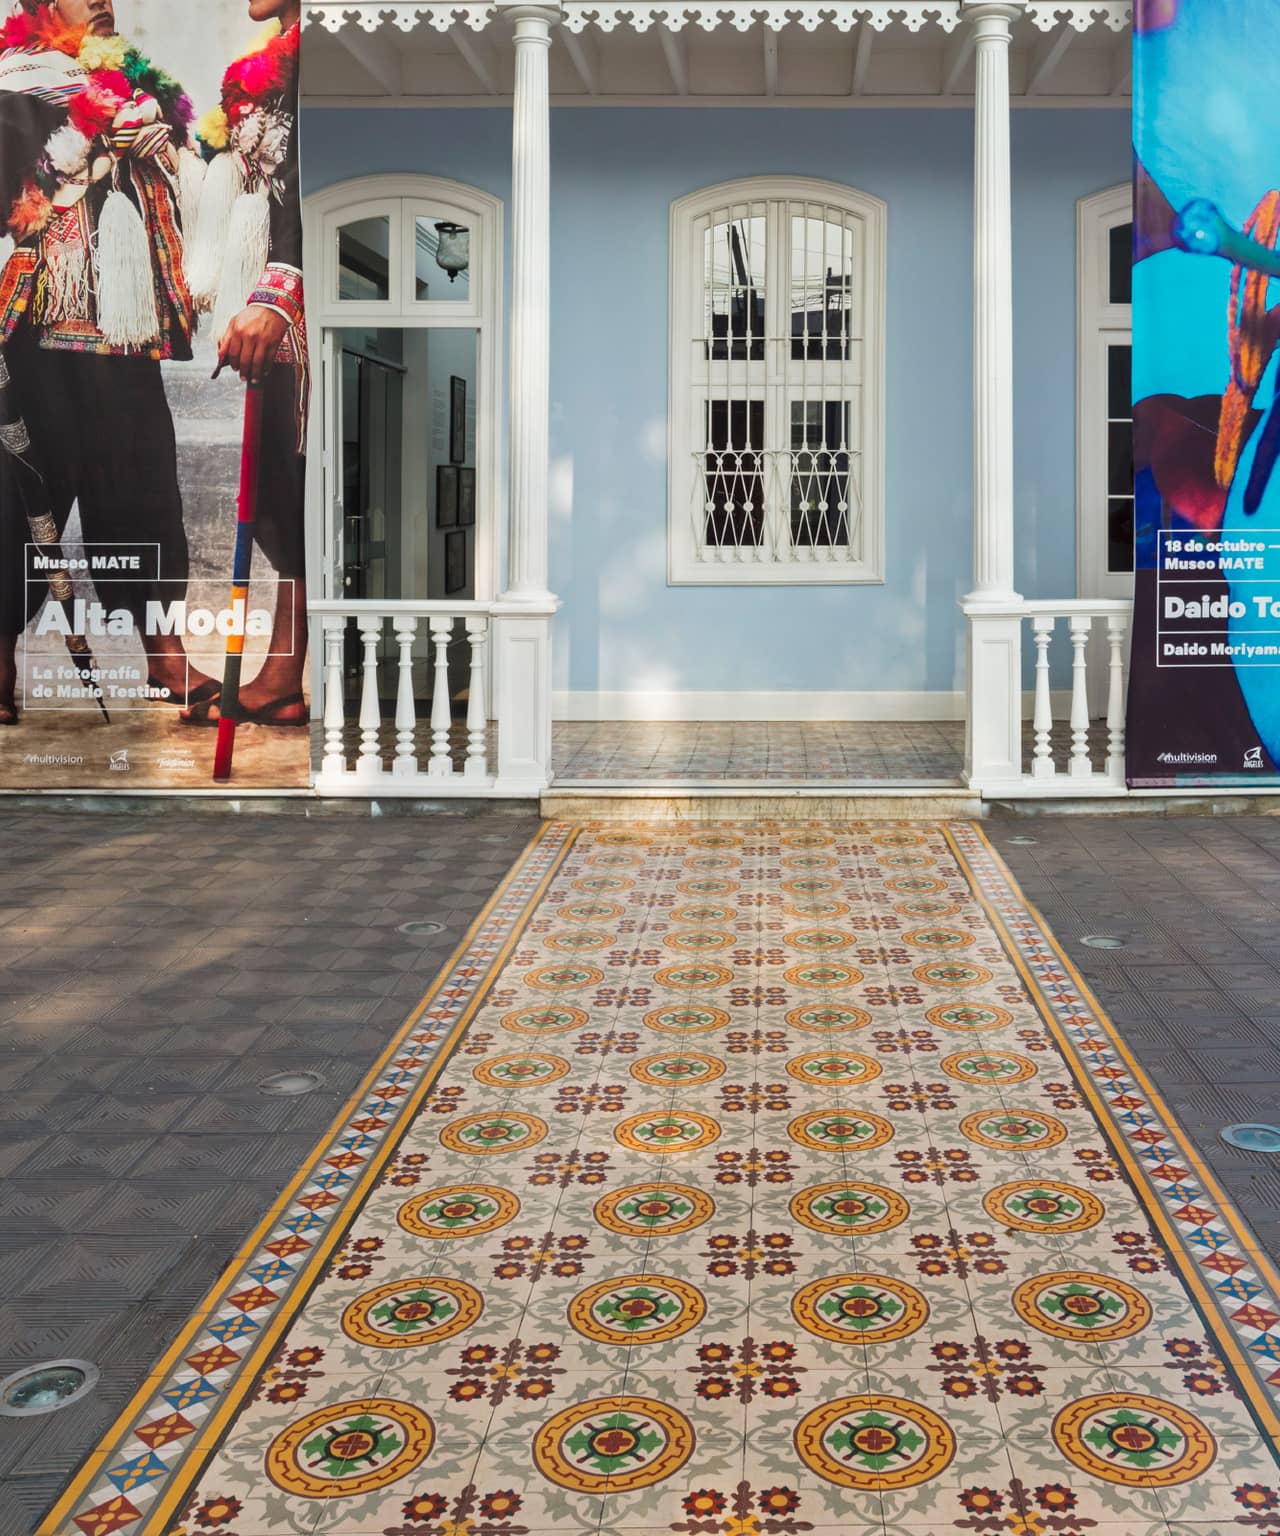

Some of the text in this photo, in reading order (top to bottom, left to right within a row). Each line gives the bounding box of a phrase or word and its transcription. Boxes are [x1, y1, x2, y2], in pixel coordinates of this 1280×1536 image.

[1165, 540, 1181, 552] 18
[1184, 540, 1203, 552] de
[1205, 540, 1265, 552] octubre
[33, 555, 140, 570] Museo MATE
[1165, 558, 1264, 570] Museo MATE
[1164, 595, 1246, 618] Daido
[35, 598, 273, 636] Alta Moda
[1164, 643, 1207, 656] Daido
[32, 665, 140, 683] La fotografía
[32, 685, 171, 698] de Mario Testino
[29, 753, 84, 764] multivision
[1164, 752, 1217, 762] multivision
